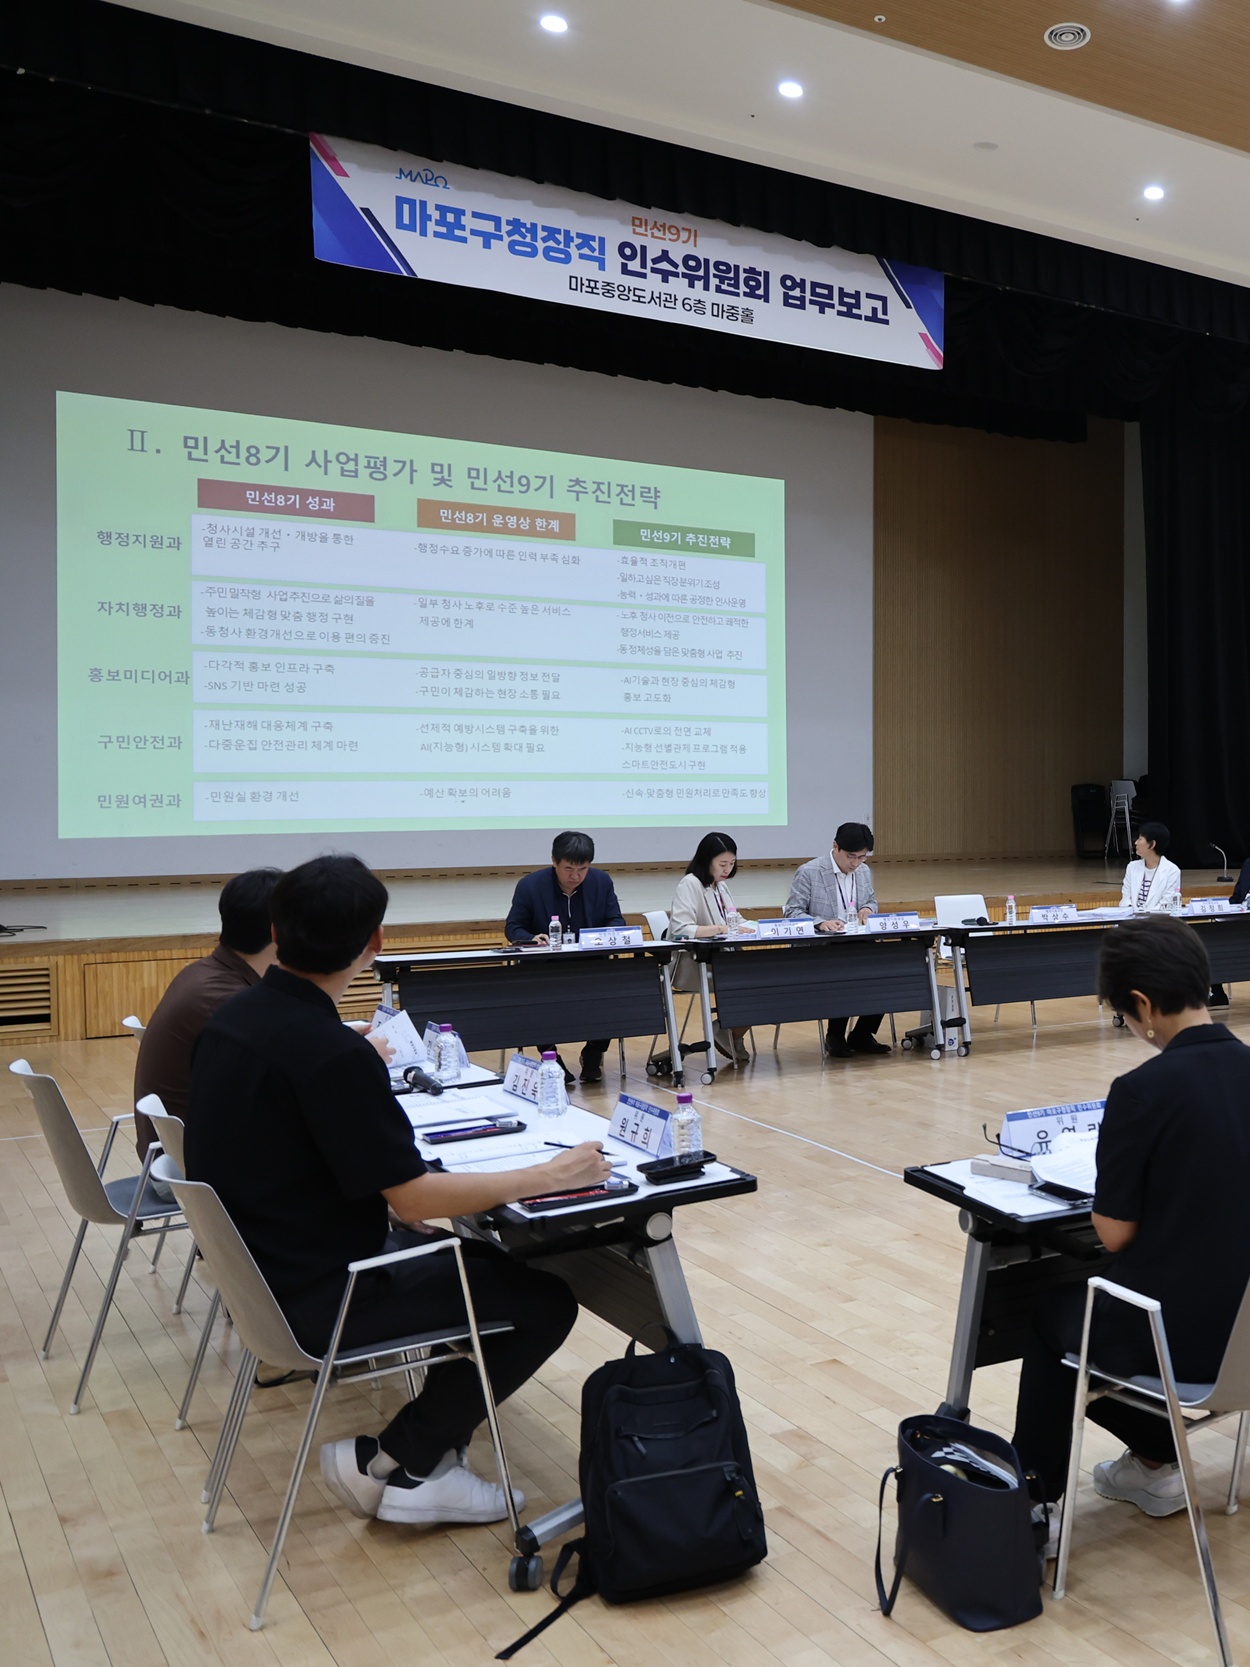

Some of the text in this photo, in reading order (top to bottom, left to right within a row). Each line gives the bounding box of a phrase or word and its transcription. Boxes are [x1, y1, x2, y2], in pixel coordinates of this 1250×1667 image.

[631, 216, 698, 248] 민선9기
[395, 195, 890, 326] 마포구청장직 인수위원회 업무보고
[569, 275, 754, 325] 마포중앙도서관 6층 마중홀
[183, 435, 660, 509] 민선8기 사업평가 및 민선9기 추진전략
[246, 490, 335, 511] 민선8기 성과
[439, 509, 559, 532] 민선8기 운영상 한계
[96, 530, 181, 550] 행정지원과
[202, 535, 280, 552] 열린 공간 추구
[258, 527, 282, 540] 개선
[295, 530, 329, 543] 개방을
[331, 533, 354, 545] 통한
[640, 528, 731, 548] 민선9기 추진전략
[462, 545, 493, 558] 증가에
[495, 549, 515, 560] 따른
[517, 550, 537, 561] 인력
[539, 553, 559, 563] 부족
[561, 554, 580, 565] 심화
[266, 590, 287, 602] 사업
[97, 601, 182, 618] 자치행정과
[205, 606, 353, 624] 높이는 체감형 맞춤 행정 구현
[441, 598, 462, 610] 청사
[464, 601, 494, 611] 노후로
[497, 602, 517, 613] 수준
[519, 604, 539, 615] 높은
[541, 605, 571, 616] 서비스
[419, 616, 473, 629] 제공에 한계
[245, 628, 316, 640] 환경개선으로
[318, 631, 341, 642] 이용
[344, 632, 365, 643] 편의
[368, 633, 390, 645] 증진
[247, 661, 271, 672] 홍보
[274, 662, 310, 673] 인프라
[312, 663, 335, 674] 구축
[453, 668, 483, 680] 중심의
[486, 669, 517, 681] 일방향
[519, 671, 539, 681] 정보
[541, 672, 560, 683] 전달
[88, 668, 190, 684] 홍보미디어과
[230, 680, 254, 692] 기반
[257, 681, 279, 692] 마련
[283, 681, 307, 693] 성공
[453, 687, 495, 698] 체감하는
[497, 688, 517, 699] 현장
[519, 689, 539, 700] 소통
[541, 689, 560, 700] 필요
[260, 720, 307, 731] 대응체계
[310, 720, 333, 731] 구축
[453, 723, 505, 735] 예방시스템
[507, 724, 537, 735] 구축을
[539, 725, 559, 736] 위한
[97, 735, 182, 749] 구민안전과
[260, 739, 307, 751] 안전관리
[311, 740, 333, 751] 체계
[336, 740, 358, 751] 마련
[470, 742, 500, 753] 시스템
[503, 742, 523, 752] 확대
[526, 742, 545, 753] 필요
[97, 793, 181, 808] 민원여권과
[249, 790, 272, 802] 환경
[276, 790, 298, 802] 개선
[447, 787, 478, 798] 확보의
[480, 787, 511, 798] 어려움
